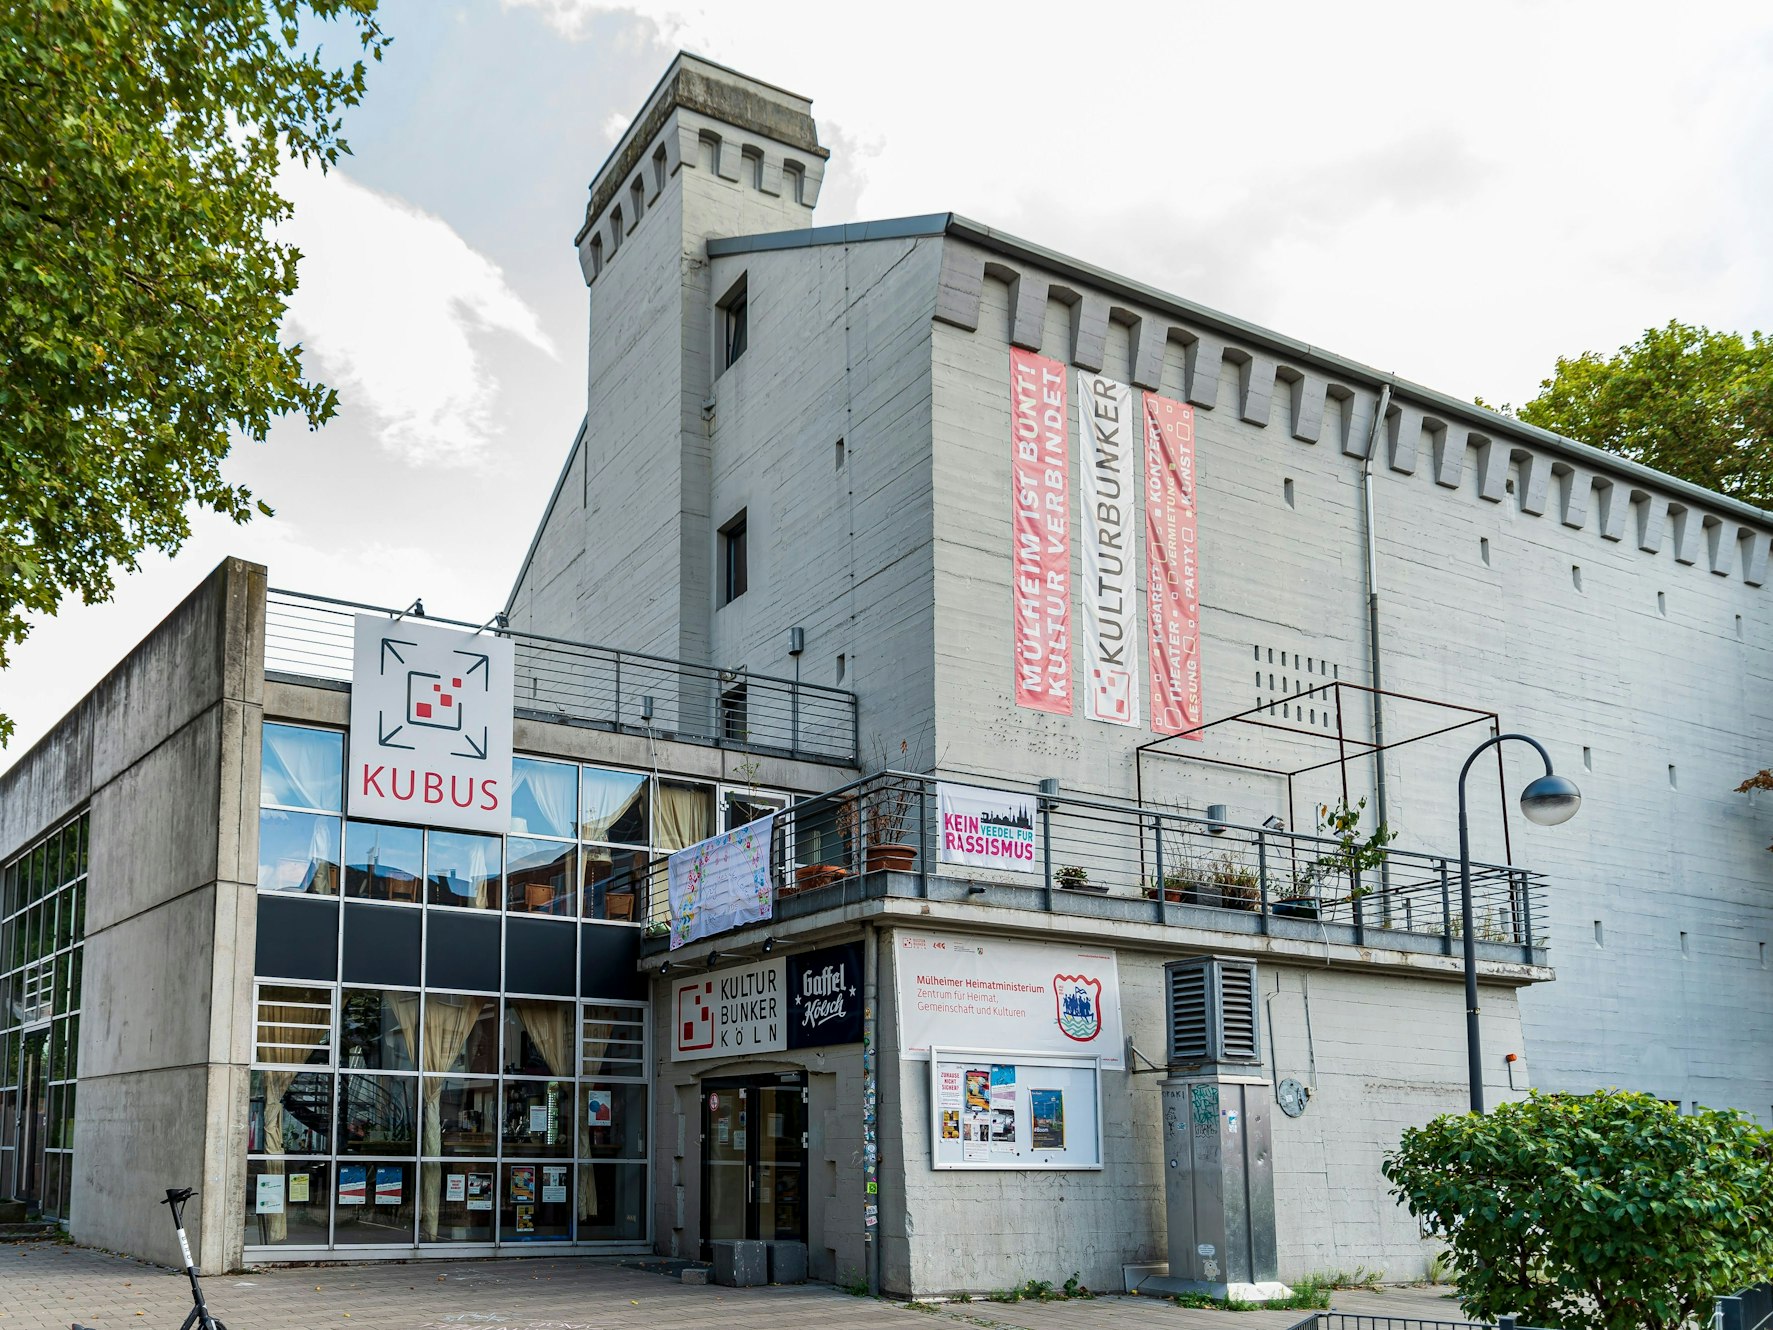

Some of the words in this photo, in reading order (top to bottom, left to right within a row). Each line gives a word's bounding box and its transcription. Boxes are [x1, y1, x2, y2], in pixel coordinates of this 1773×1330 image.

[1017, 363, 1039, 463] BUNT!
[1042, 367, 1065, 554] VERBINDET
[1147, 416, 1162, 503] KONZERT
[1180, 443, 1193, 506] KUNST
[1019, 470, 1041, 519] IST
[1093, 378, 1125, 667] KULTURBUNKER
[1166, 476, 1178, 567] VERMIETUNG
[1183, 544, 1195, 599] PARTY
[1017, 533, 1043, 692] MÜLHEIM
[1046, 570, 1067, 698] KULTUR
[1168, 620, 1183, 702] THEATER
[1186, 660, 1199, 723] LESUNG
[363, 763, 499, 811] KUBUS
[944, 812, 979, 834] KEIN
[945, 832, 1033, 861] RASSISMUS
[980, 825, 1014, 839] VEEDEL
[721, 969, 777, 1001] KULTUR
[802, 963, 847, 997] Gaffel
[916, 975, 964, 988] Mülheimer
[965, 978, 1045, 994] Heimatministerium
[917, 988, 952, 999] Zentrum
[954, 990, 965, 1001] für
[967, 992, 999, 1004] Heimat,
[721, 997, 777, 1025] BUNKER
[801, 993, 847, 1028] Kölsch
[917, 1001, 975, 1015] Gemeinschaft
[976, 1006, 992, 1016] und
[993, 1006, 1026, 1018] Kulturen
[721, 1024, 777, 1048] KÖLN
